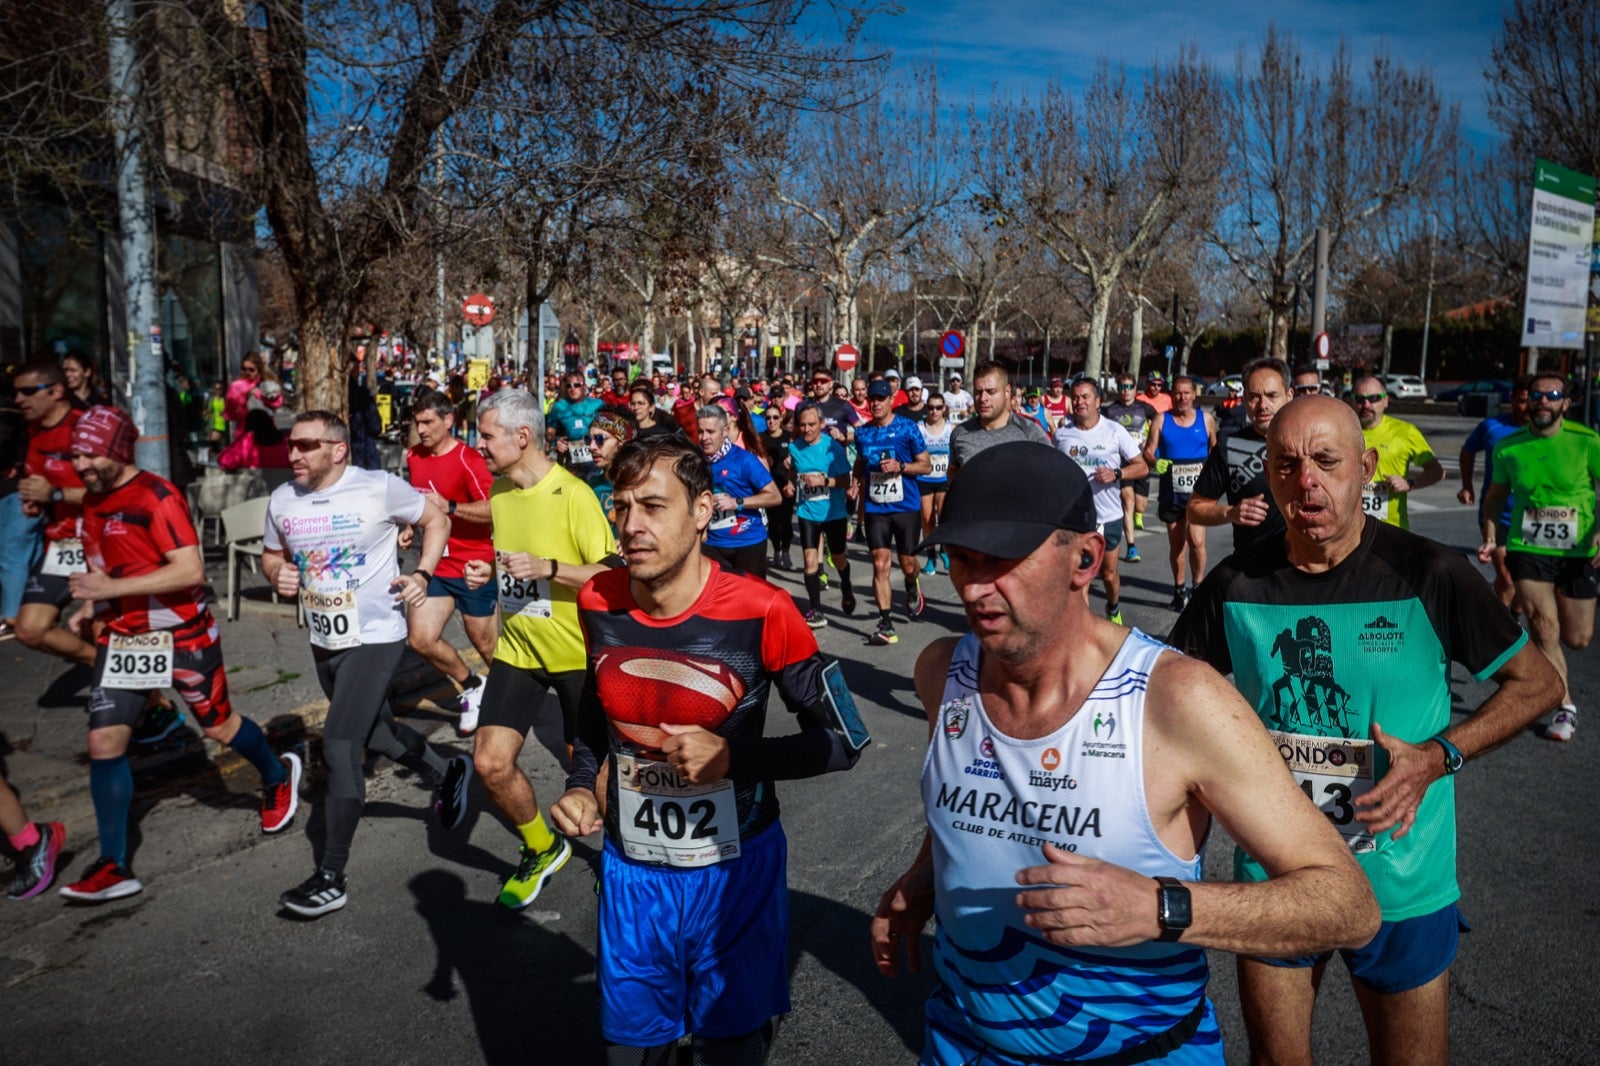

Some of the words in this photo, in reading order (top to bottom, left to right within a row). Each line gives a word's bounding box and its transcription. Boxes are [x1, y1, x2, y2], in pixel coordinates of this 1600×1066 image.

[873, 483, 897, 496] 274
[282, 518, 292, 536] 9
[292, 515, 329, 526] Carrera
[1530, 523, 1570, 540] 753
[501, 574, 540, 602] 354
[311, 612, 349, 637] 590
[1358, 631, 1405, 640] ALBOLOTE
[109, 653, 167, 675] 3038
[1088, 749, 1126, 759] Maracena
[1028, 774, 1078, 792] mayfo
[633, 798, 719, 841] 402
[935, 782, 1103, 838] MARACENA
[952, 820, 984, 835] CLUB
[988, 827, 1006, 838] DE
